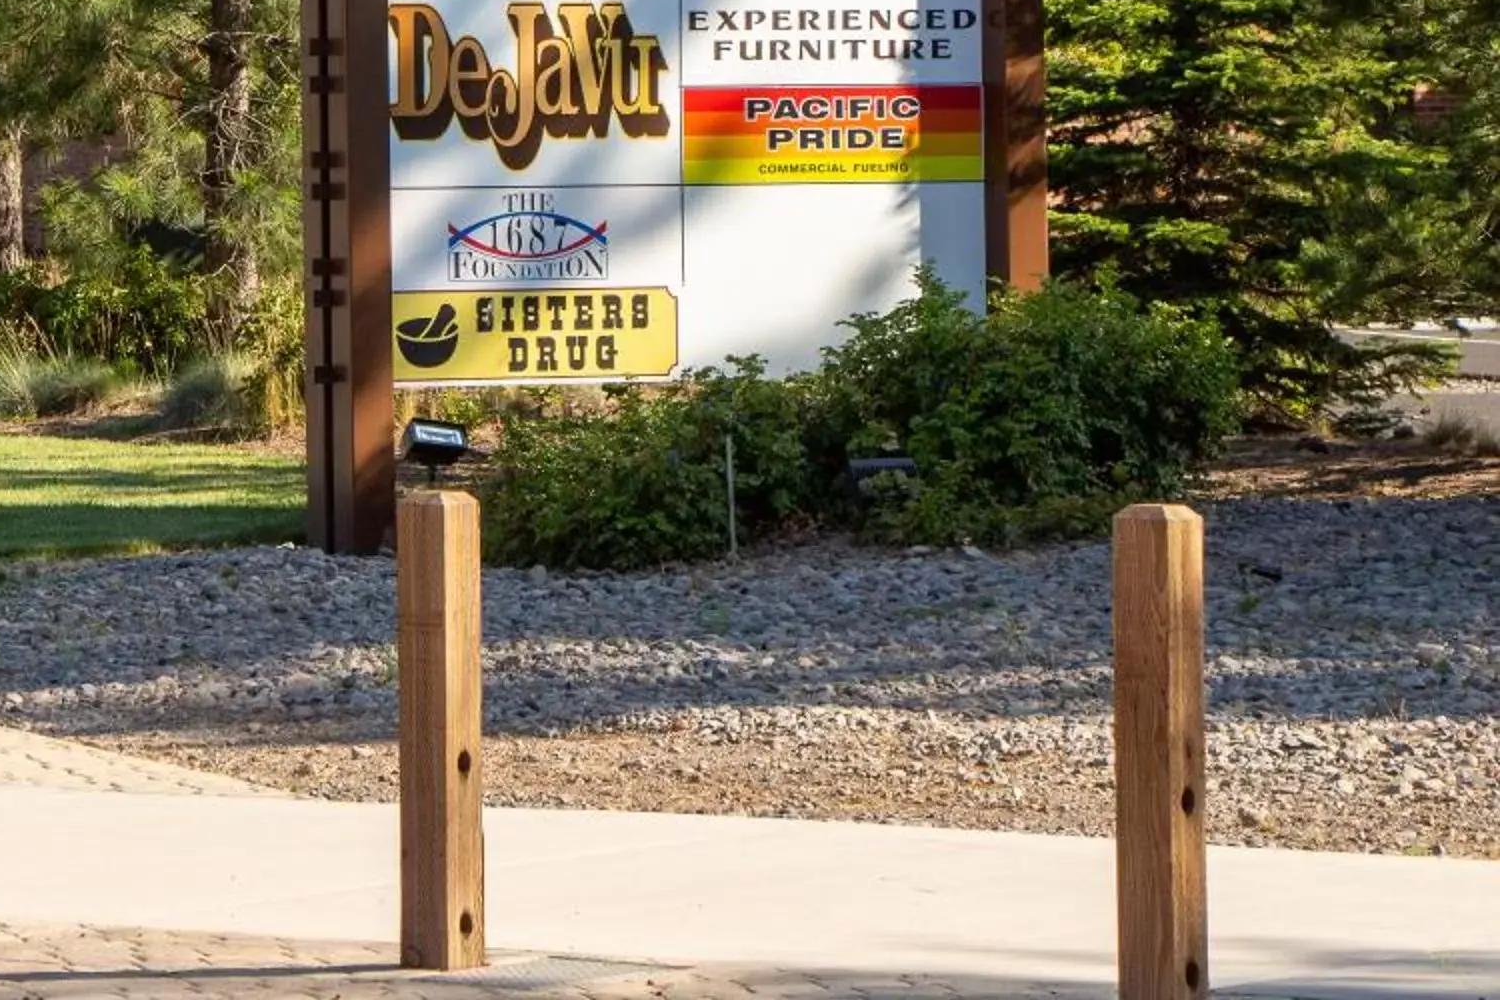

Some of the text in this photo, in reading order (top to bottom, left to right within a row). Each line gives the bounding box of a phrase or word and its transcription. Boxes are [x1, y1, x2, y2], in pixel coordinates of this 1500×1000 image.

[687, 8, 977, 32] EXPERIENCED
[712, 38, 953, 61] FURNITURE
[743, 95, 921, 121] PACIFIC
[766, 126, 906, 152] PRIDE
[758, 162, 910, 175] COMMERCIAL FUELING
[502, 192, 555, 214] THE
[490, 216, 570, 257] 1687
[476, 294, 649, 332] SISTERS
[508, 335, 618, 373] DRUG
